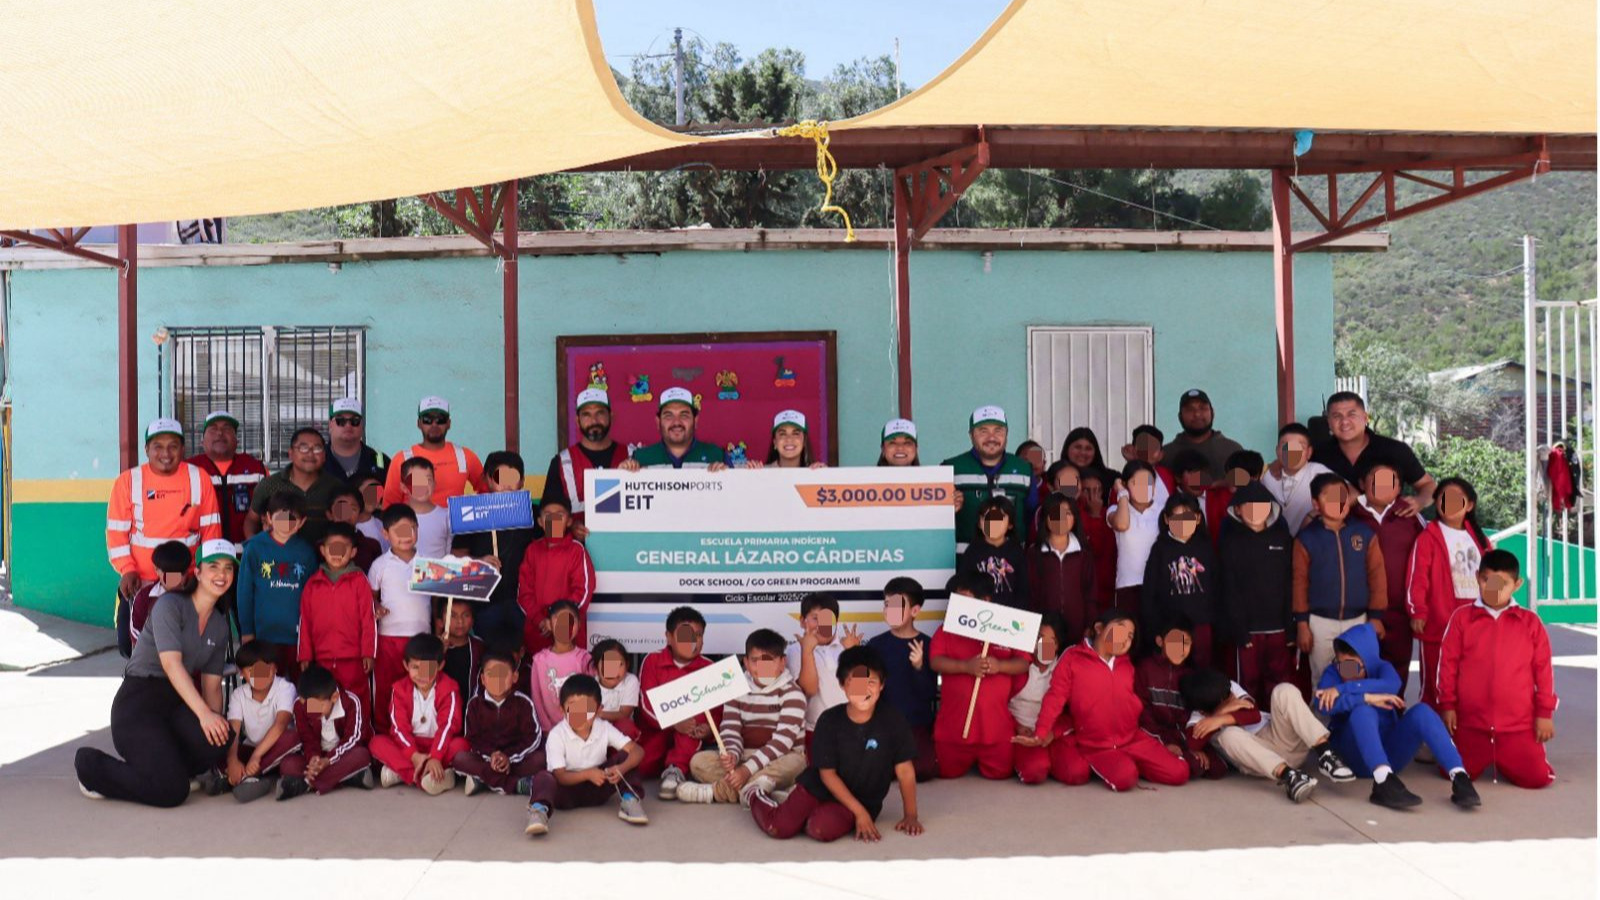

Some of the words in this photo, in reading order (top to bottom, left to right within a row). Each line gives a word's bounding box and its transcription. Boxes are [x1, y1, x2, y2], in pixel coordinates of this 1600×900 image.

[625, 495, 654, 510] EIT
[816, 487, 906, 505] $3,000.00
[910, 487, 947, 501] USD
[700, 537, 742, 546] ESCUELA
[744, 537, 790, 546] PRIMARIA
[791, 535, 837, 545] INDÍGENA
[635, 550, 721, 565] GENERAL
[724, 547, 800, 565] LÁZARO
[803, 546, 905, 564] CÁRDENAS
[679, 578, 706, 586] DOCK
[707, 578, 745, 587] SCHOOL
[751, 578, 766, 586] GO
[767, 577, 799, 586] GREEN
[800, 577, 861, 586] PROGRAMME
[725, 593, 746, 602] Ciclo
[747, 593, 776, 602] Escolar
[659, 693, 692, 713] DOCK
[690, 679, 727, 703] School
